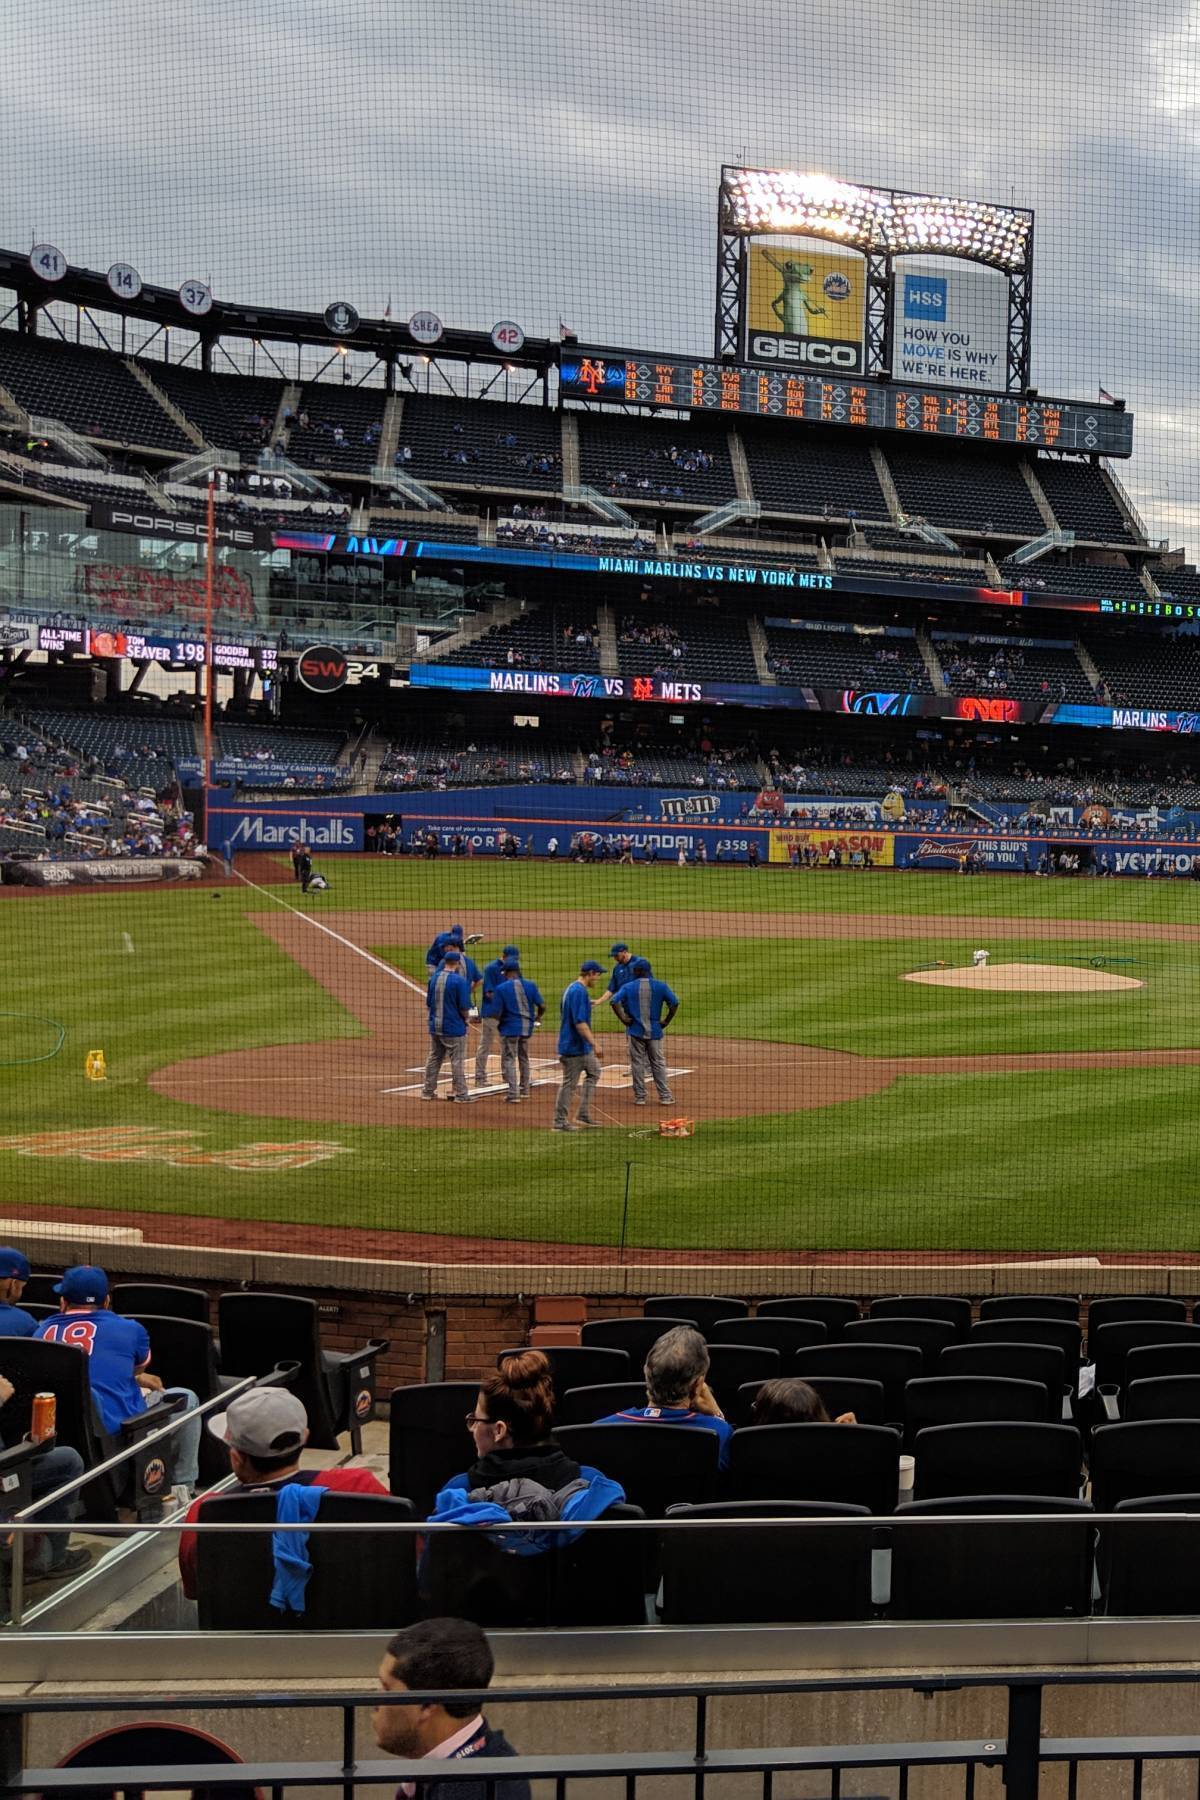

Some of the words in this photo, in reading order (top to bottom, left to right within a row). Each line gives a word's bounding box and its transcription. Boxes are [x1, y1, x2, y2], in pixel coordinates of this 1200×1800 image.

[40, 253, 58, 272] 41
[117, 272, 132, 288] 14
[186, 289, 205, 306] 37
[909, 291, 943, 307] HSS
[412, 319, 439, 333] SHEA
[497, 329, 518, 344] 42
[904, 327, 938, 343] HOW
[940, 331, 970, 346] YOU
[753, 336, 857, 367] GEICO
[903, 342, 944, 359] MOVE
[948, 349, 961, 362] IS
[965, 350, 998, 366] WHY
[698, 363, 765, 376] AMERICAN
[774, 371, 822, 383] LEAGUE
[902, 361, 946, 377] WE'RE
[950, 368, 991, 382] HERE.
[721, 401, 740, 410] BOS
[960, 393, 1018, 406] NATIONAL
[1026, 400, 1071, 412] LEAGUE
[112, 511, 254, 544] PORSCHE
[599, 558, 638, 574] MIAMI
[644, 561, 701, 578] MARLINS
[707, 566, 724, 581] VS
[729, 568, 756, 583] NEW
[762, 570, 794, 586] YORK
[799, 574, 833, 589] METS
[40, 629, 82, 642] ALL-TIME
[823, 624, 846, 633] LIGHT
[40, 639, 65, 651] WINS
[127, 635, 145, 645] TOM
[986, 636, 1008, 645] LIGHT
[126, 645, 171, 661] SEAVER
[176, 643, 205, 662] 198
[215, 644, 249, 657] GOODEN
[261, 650, 278, 660] 157
[214, 655, 255, 668] KOOSMAN
[261, 661, 278, 670] 140
[302, 661, 346, 678] SW
[347, 662, 380, 679] 24
[490, 672, 560, 693] MARLINS
[604, 678, 624, 696] VS
[662, 681, 701, 701] METS
[1112, 709, 1167, 728] MARLINS
[215, 761, 237, 769] LONG
[271, 763, 289, 771] ONLY
[290, 765, 316, 773] CASINO
[231, 816, 354, 845] Marshalls
[723, 839, 748, 851] 358
[820, 835, 886, 856] MASON
[919, 843, 969, 855] Budweiser
[977, 841, 998, 852] THIS
[1000, 842, 1028, 852] BUD'S
[997, 853, 1018, 863] YOU.
